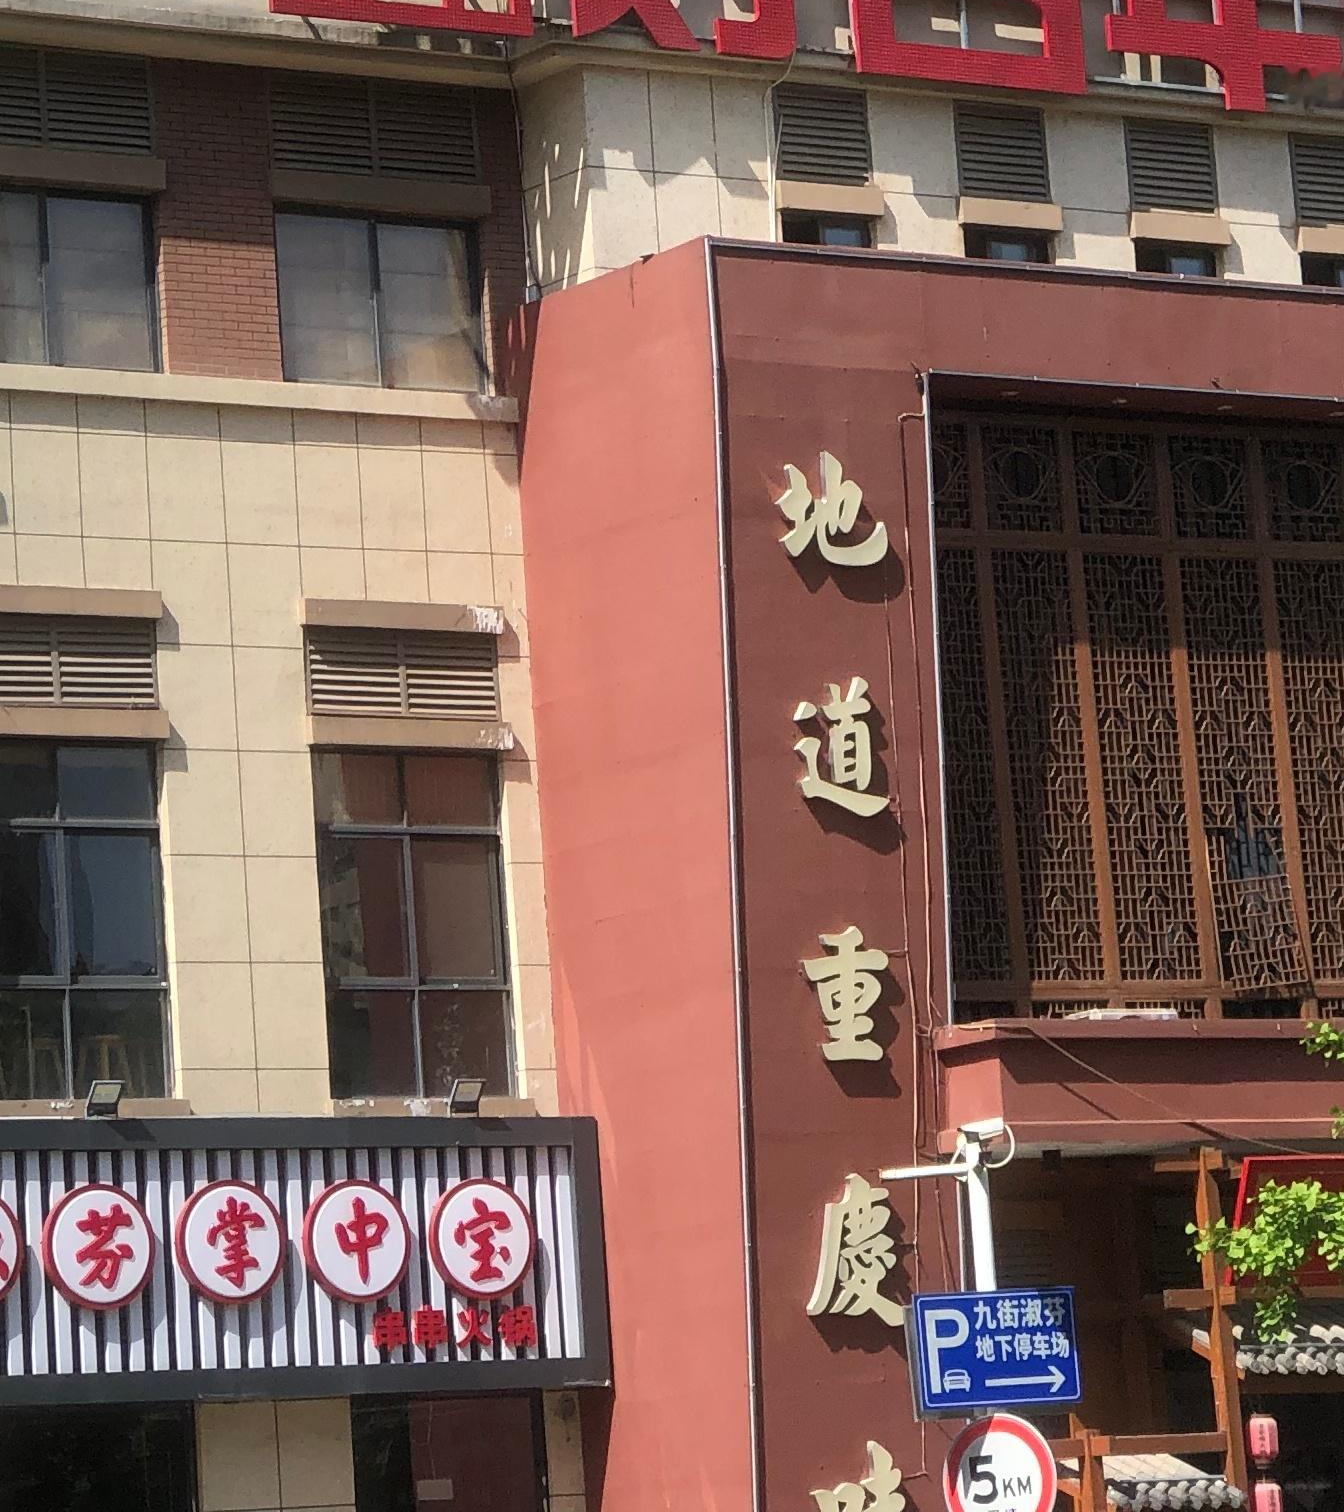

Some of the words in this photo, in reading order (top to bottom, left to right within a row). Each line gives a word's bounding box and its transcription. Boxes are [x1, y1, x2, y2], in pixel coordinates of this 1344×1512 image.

[372, 1304, 538, 1352] 串串火锅
[973, 1296, 1066, 1330] 九街淑芬
[924, 1308, 970, 1394] P
[975, 1332, 1070, 1362] 地下停车场
